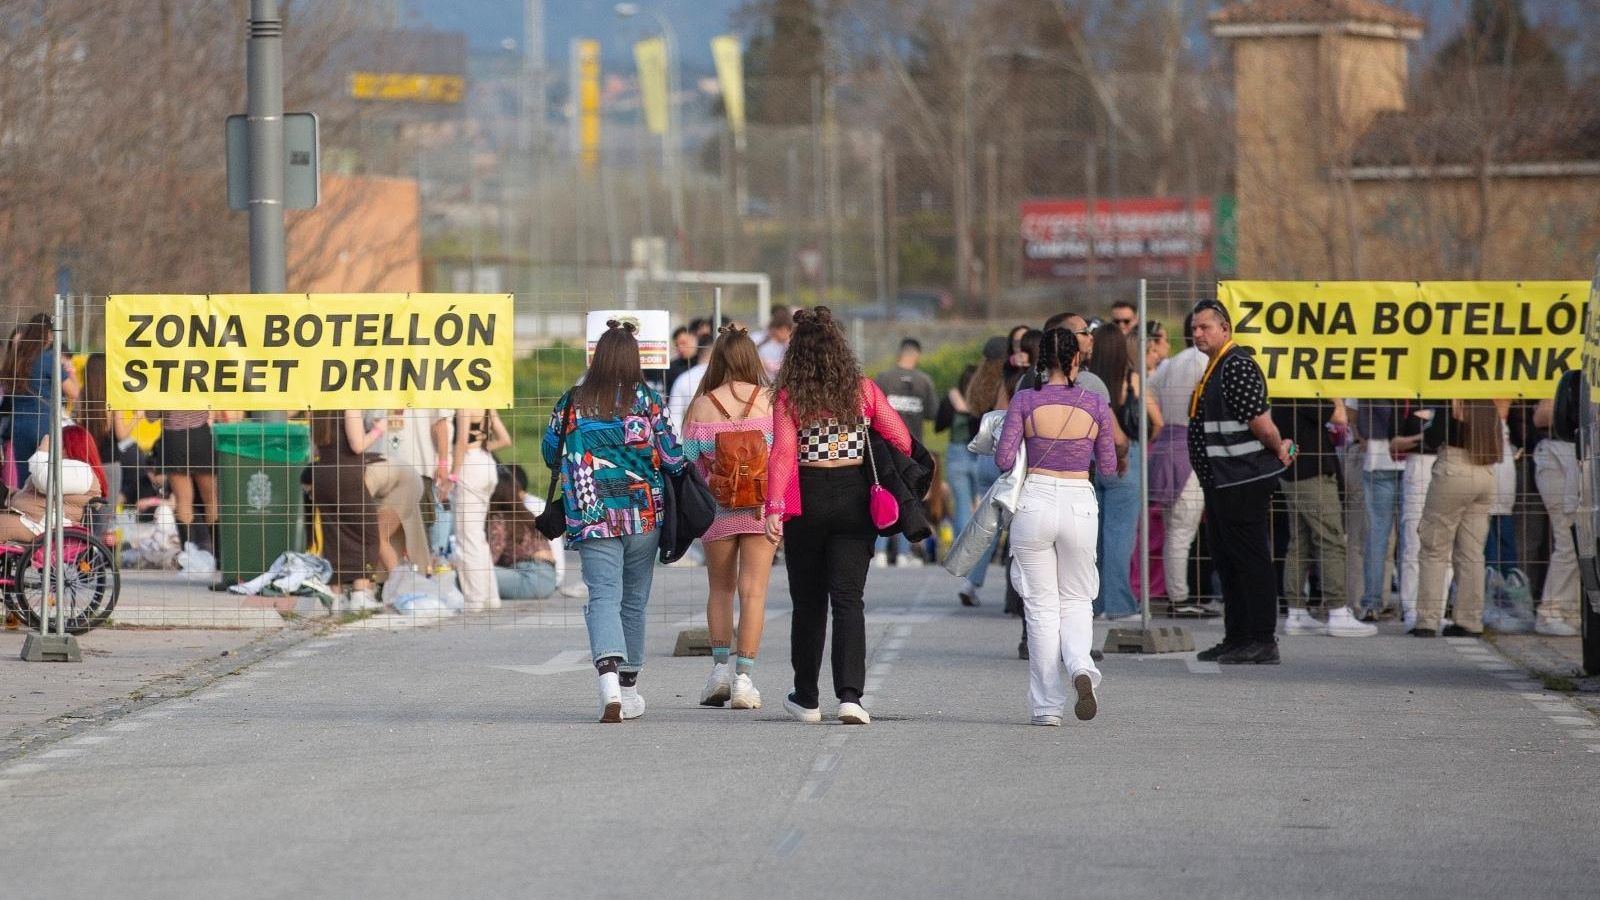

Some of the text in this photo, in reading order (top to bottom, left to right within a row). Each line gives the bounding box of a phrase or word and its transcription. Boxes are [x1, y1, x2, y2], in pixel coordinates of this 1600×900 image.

[124, 304, 497, 348] ZONA BOTELLÓN
[1234, 292, 1589, 336] ZONA BOTELLÓ
[122, 357, 492, 393] STREET DRINKS
[1249, 347, 1409, 381] TREET
[1429, 347, 1584, 381] DRINK
